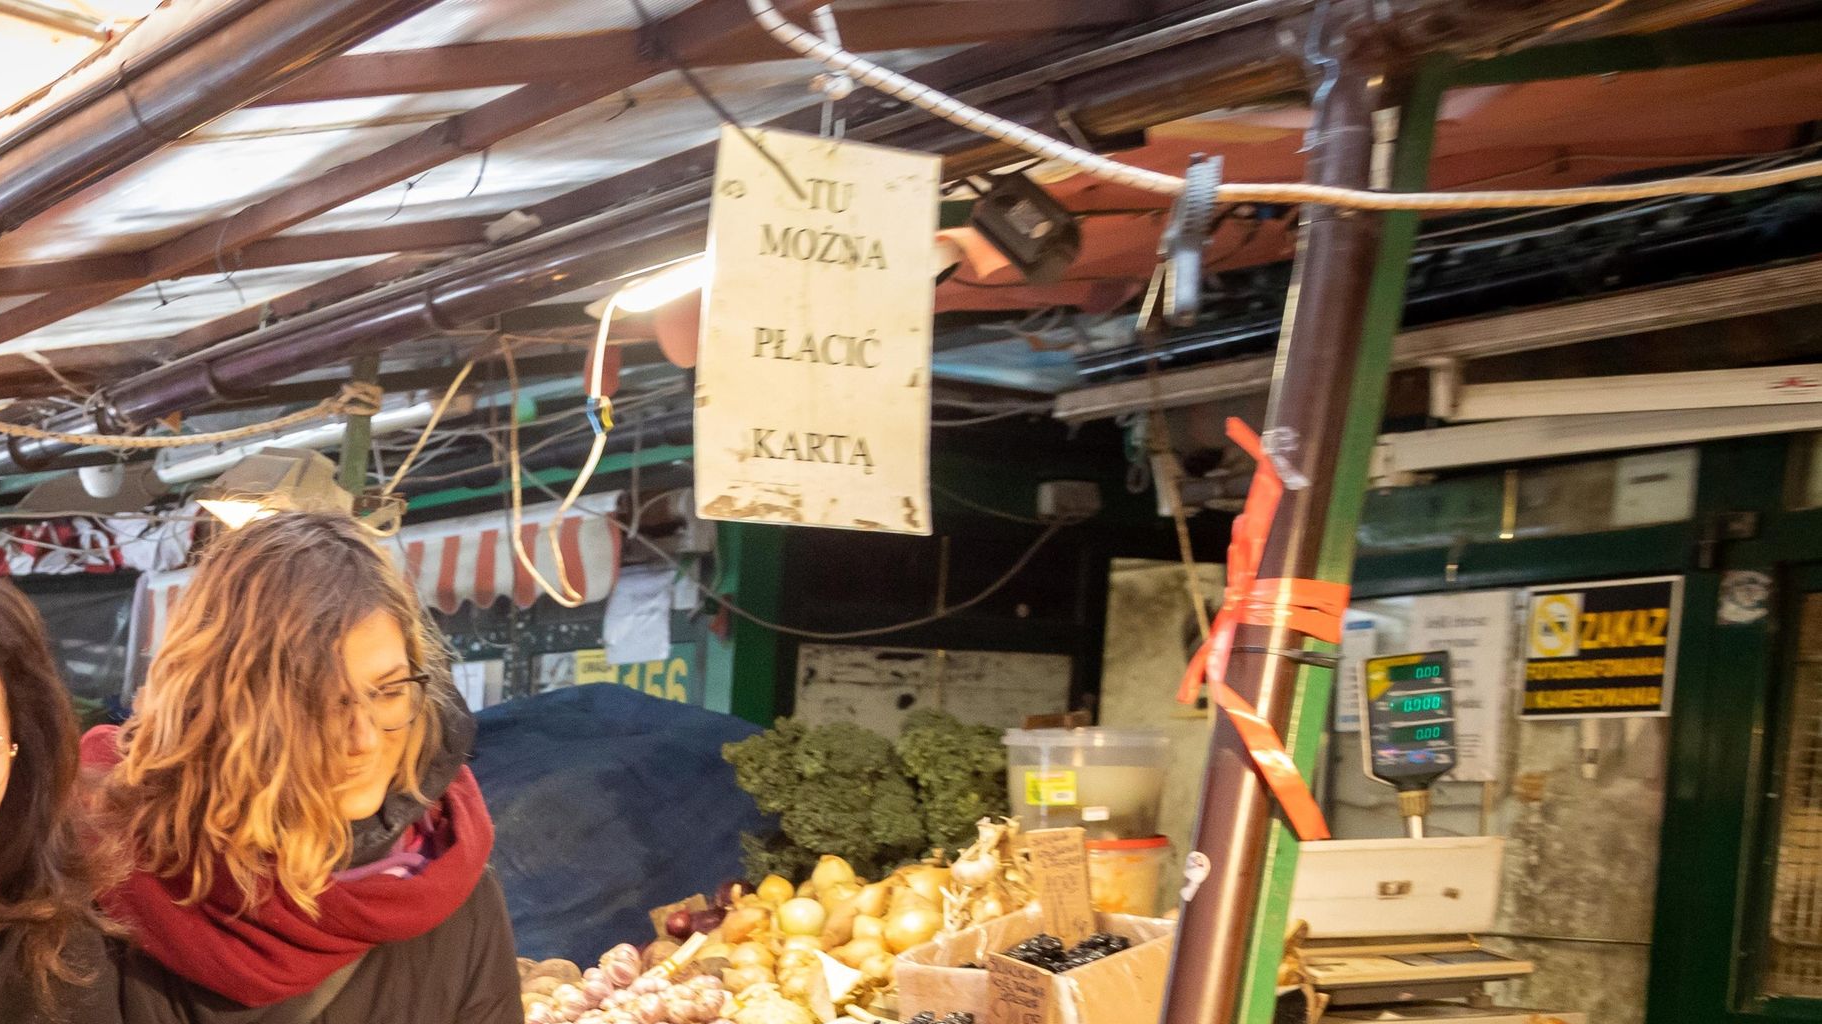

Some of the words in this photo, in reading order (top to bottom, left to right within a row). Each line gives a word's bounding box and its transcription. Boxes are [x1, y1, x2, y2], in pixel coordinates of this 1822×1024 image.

[803, 177, 856, 214] TU
[758, 222, 889, 270] MOŻNA
[752, 324, 881, 370] PŁACIĆ
[751, 427, 876, 474] KARTĄ
[1580, 608, 1668, 648] ZAKAZ
